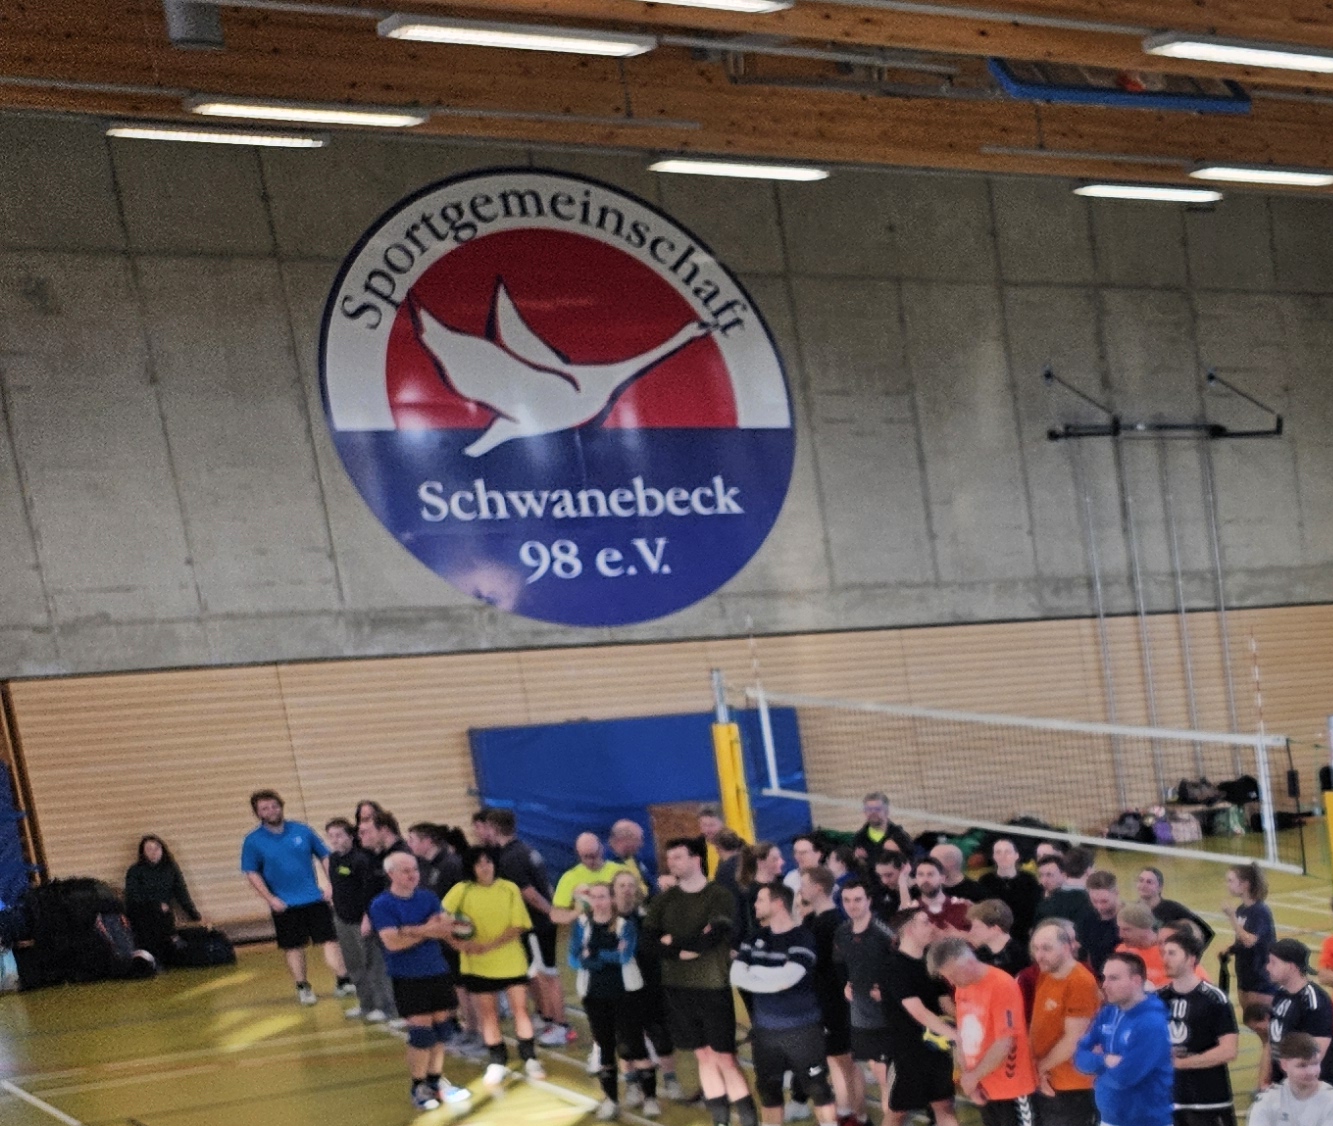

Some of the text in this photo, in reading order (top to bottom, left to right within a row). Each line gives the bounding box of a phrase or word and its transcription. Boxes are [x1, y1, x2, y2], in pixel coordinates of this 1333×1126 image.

[341, 186, 745, 337] Sportgemeinschaft
[418, 476, 744, 522] Schwanebeck
[519, 538, 671, 584] 98 e.V.
